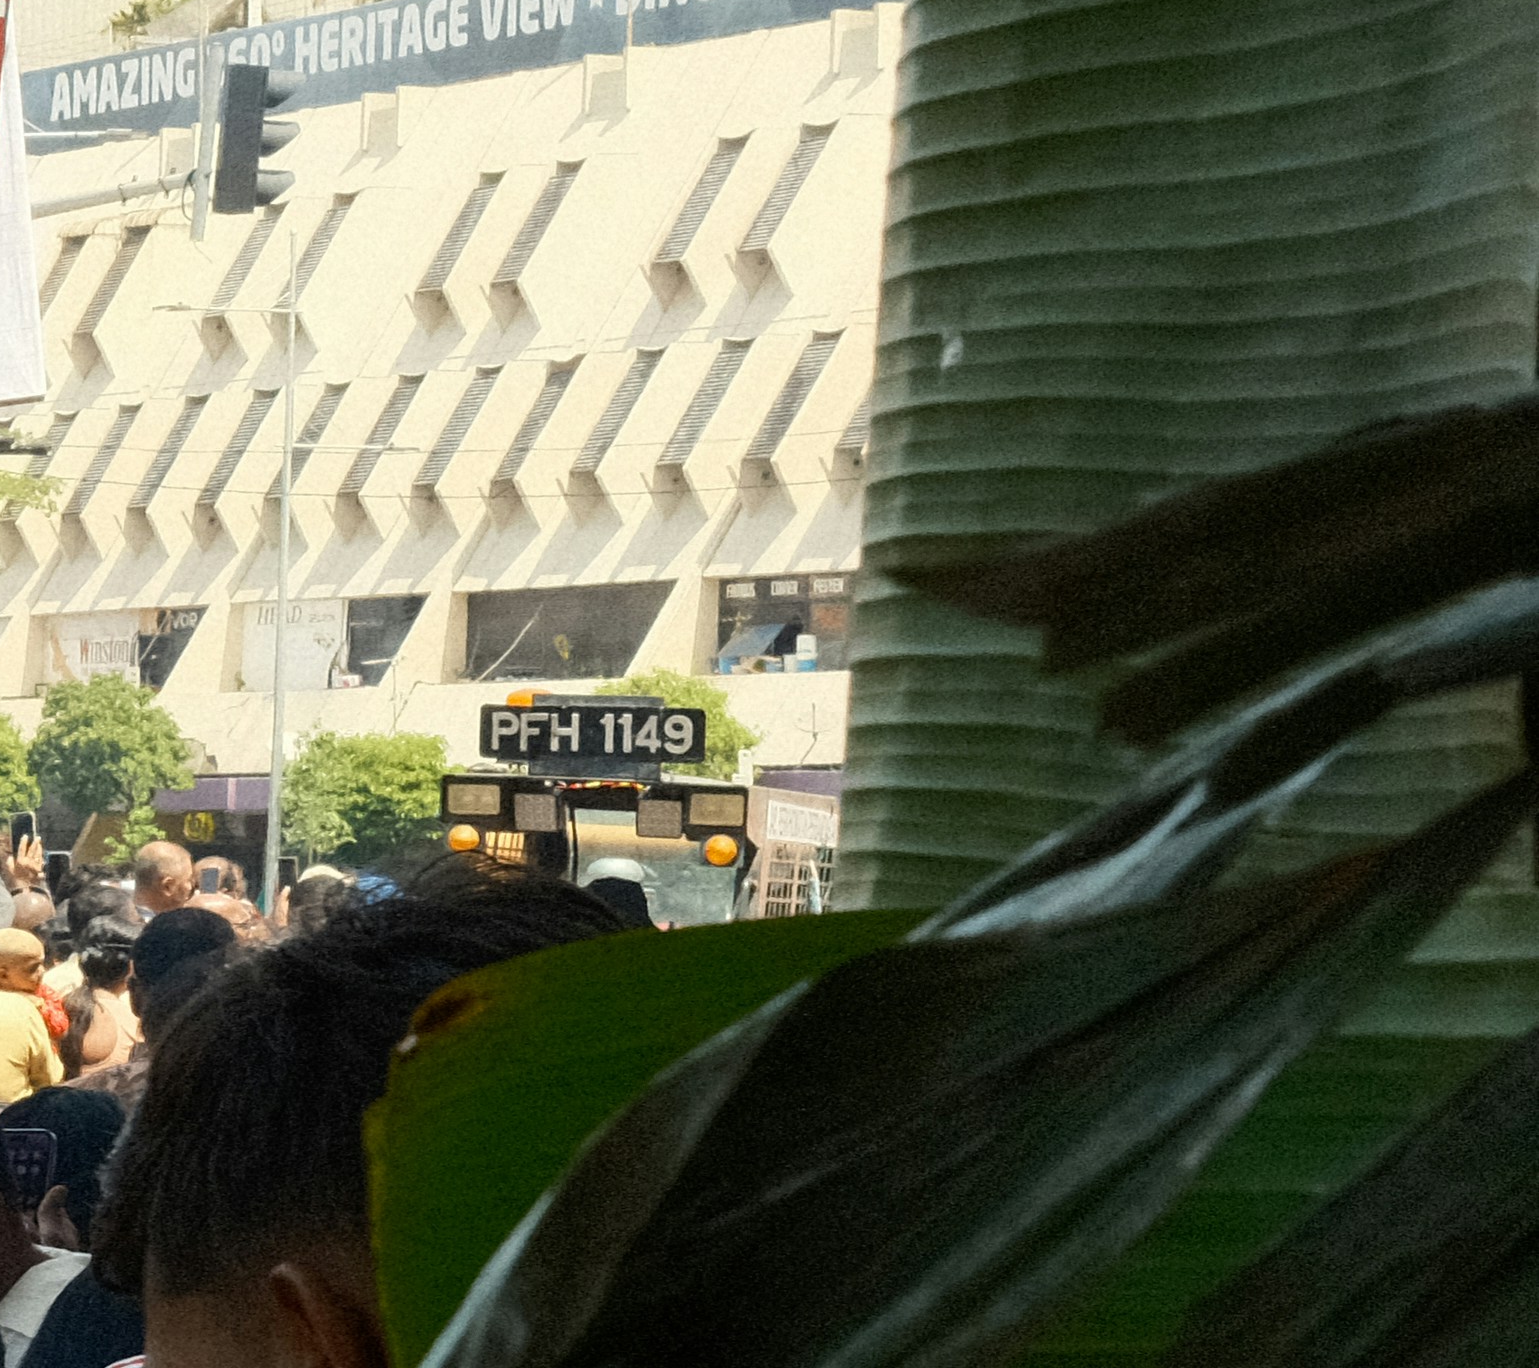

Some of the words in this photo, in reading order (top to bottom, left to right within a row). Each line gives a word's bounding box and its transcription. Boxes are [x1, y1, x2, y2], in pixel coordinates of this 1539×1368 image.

[49, 48, 196, 123] AMAZING
[490, 711, 581, 753] PFH
[599, 712, 695, 755] 1149
